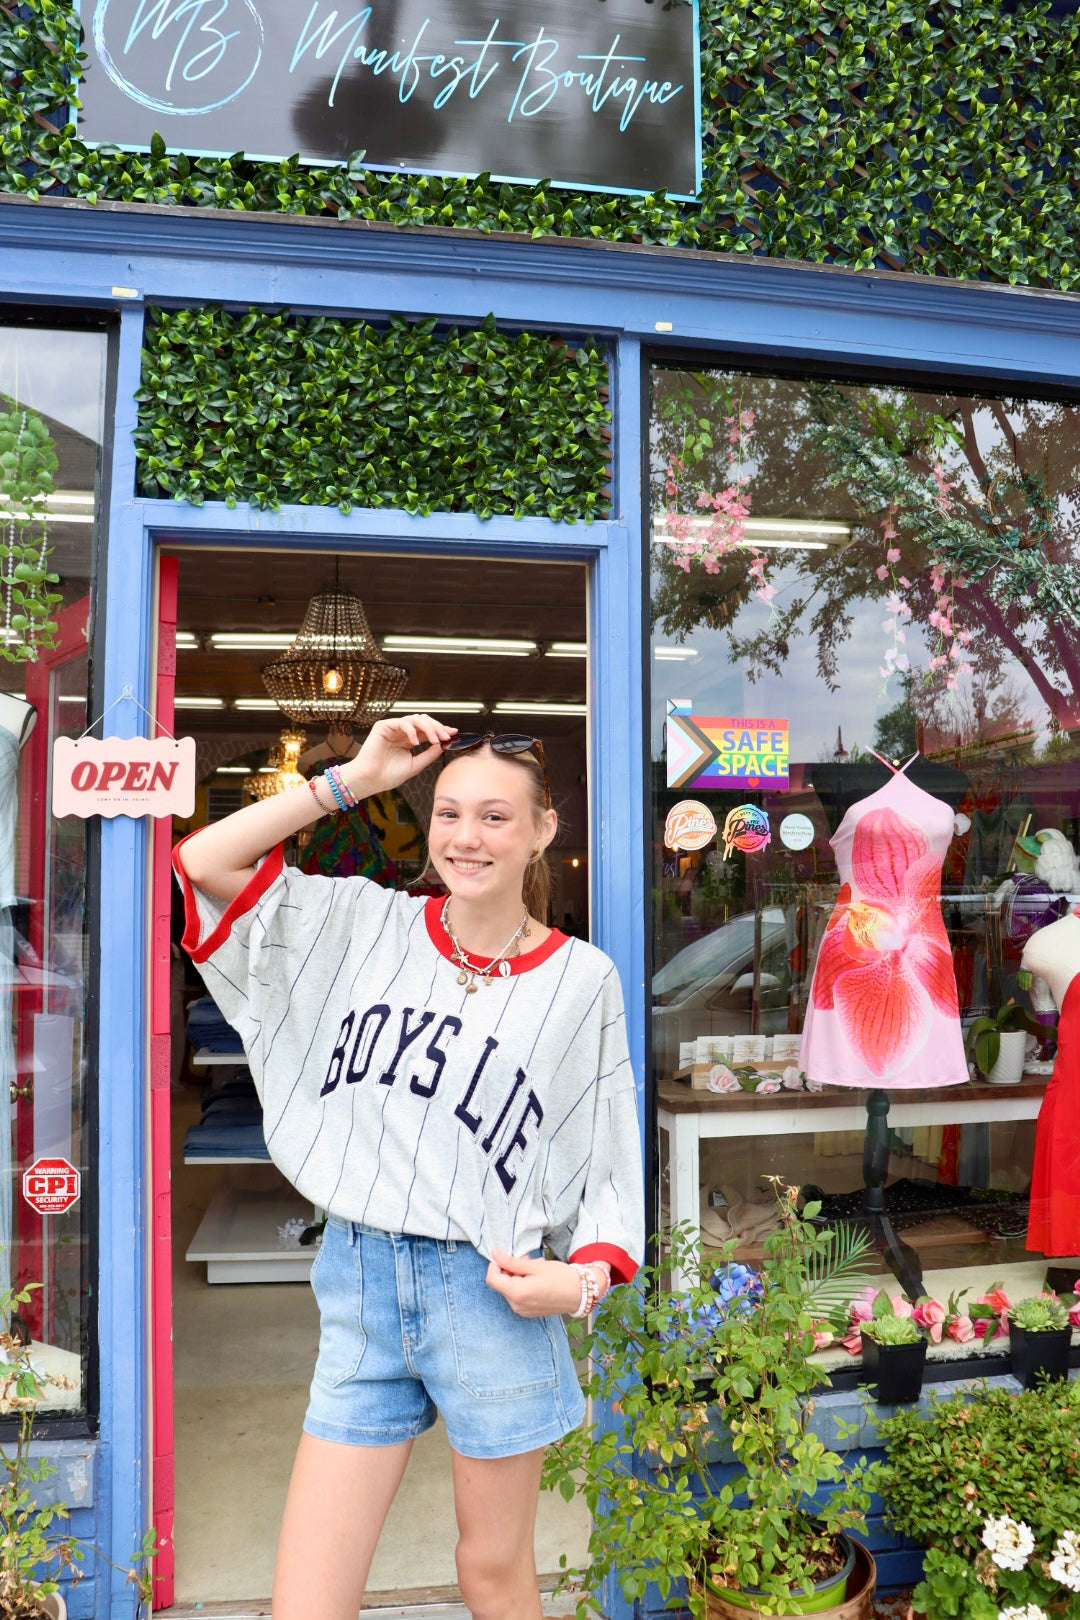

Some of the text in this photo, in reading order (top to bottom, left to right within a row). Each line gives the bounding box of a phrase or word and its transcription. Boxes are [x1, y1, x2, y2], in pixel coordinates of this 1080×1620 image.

[289, 6, 685, 132] Manifest Boutique
[730, 718, 776, 728] THIS IS A
[722, 730, 784, 752] SAFE
[71, 761, 179, 791] OPEN
[718, 754, 788, 776] SPACE
[667, 814, 714, 844] Pines
[727, 818, 768, 844] Pines
[320, 1003, 463, 1099] BOYS
[35, 1167, 69, 1175] WARNING
[28, 1176, 75, 1194] CPI
[35, 1196, 69, 1204] SECURITY
